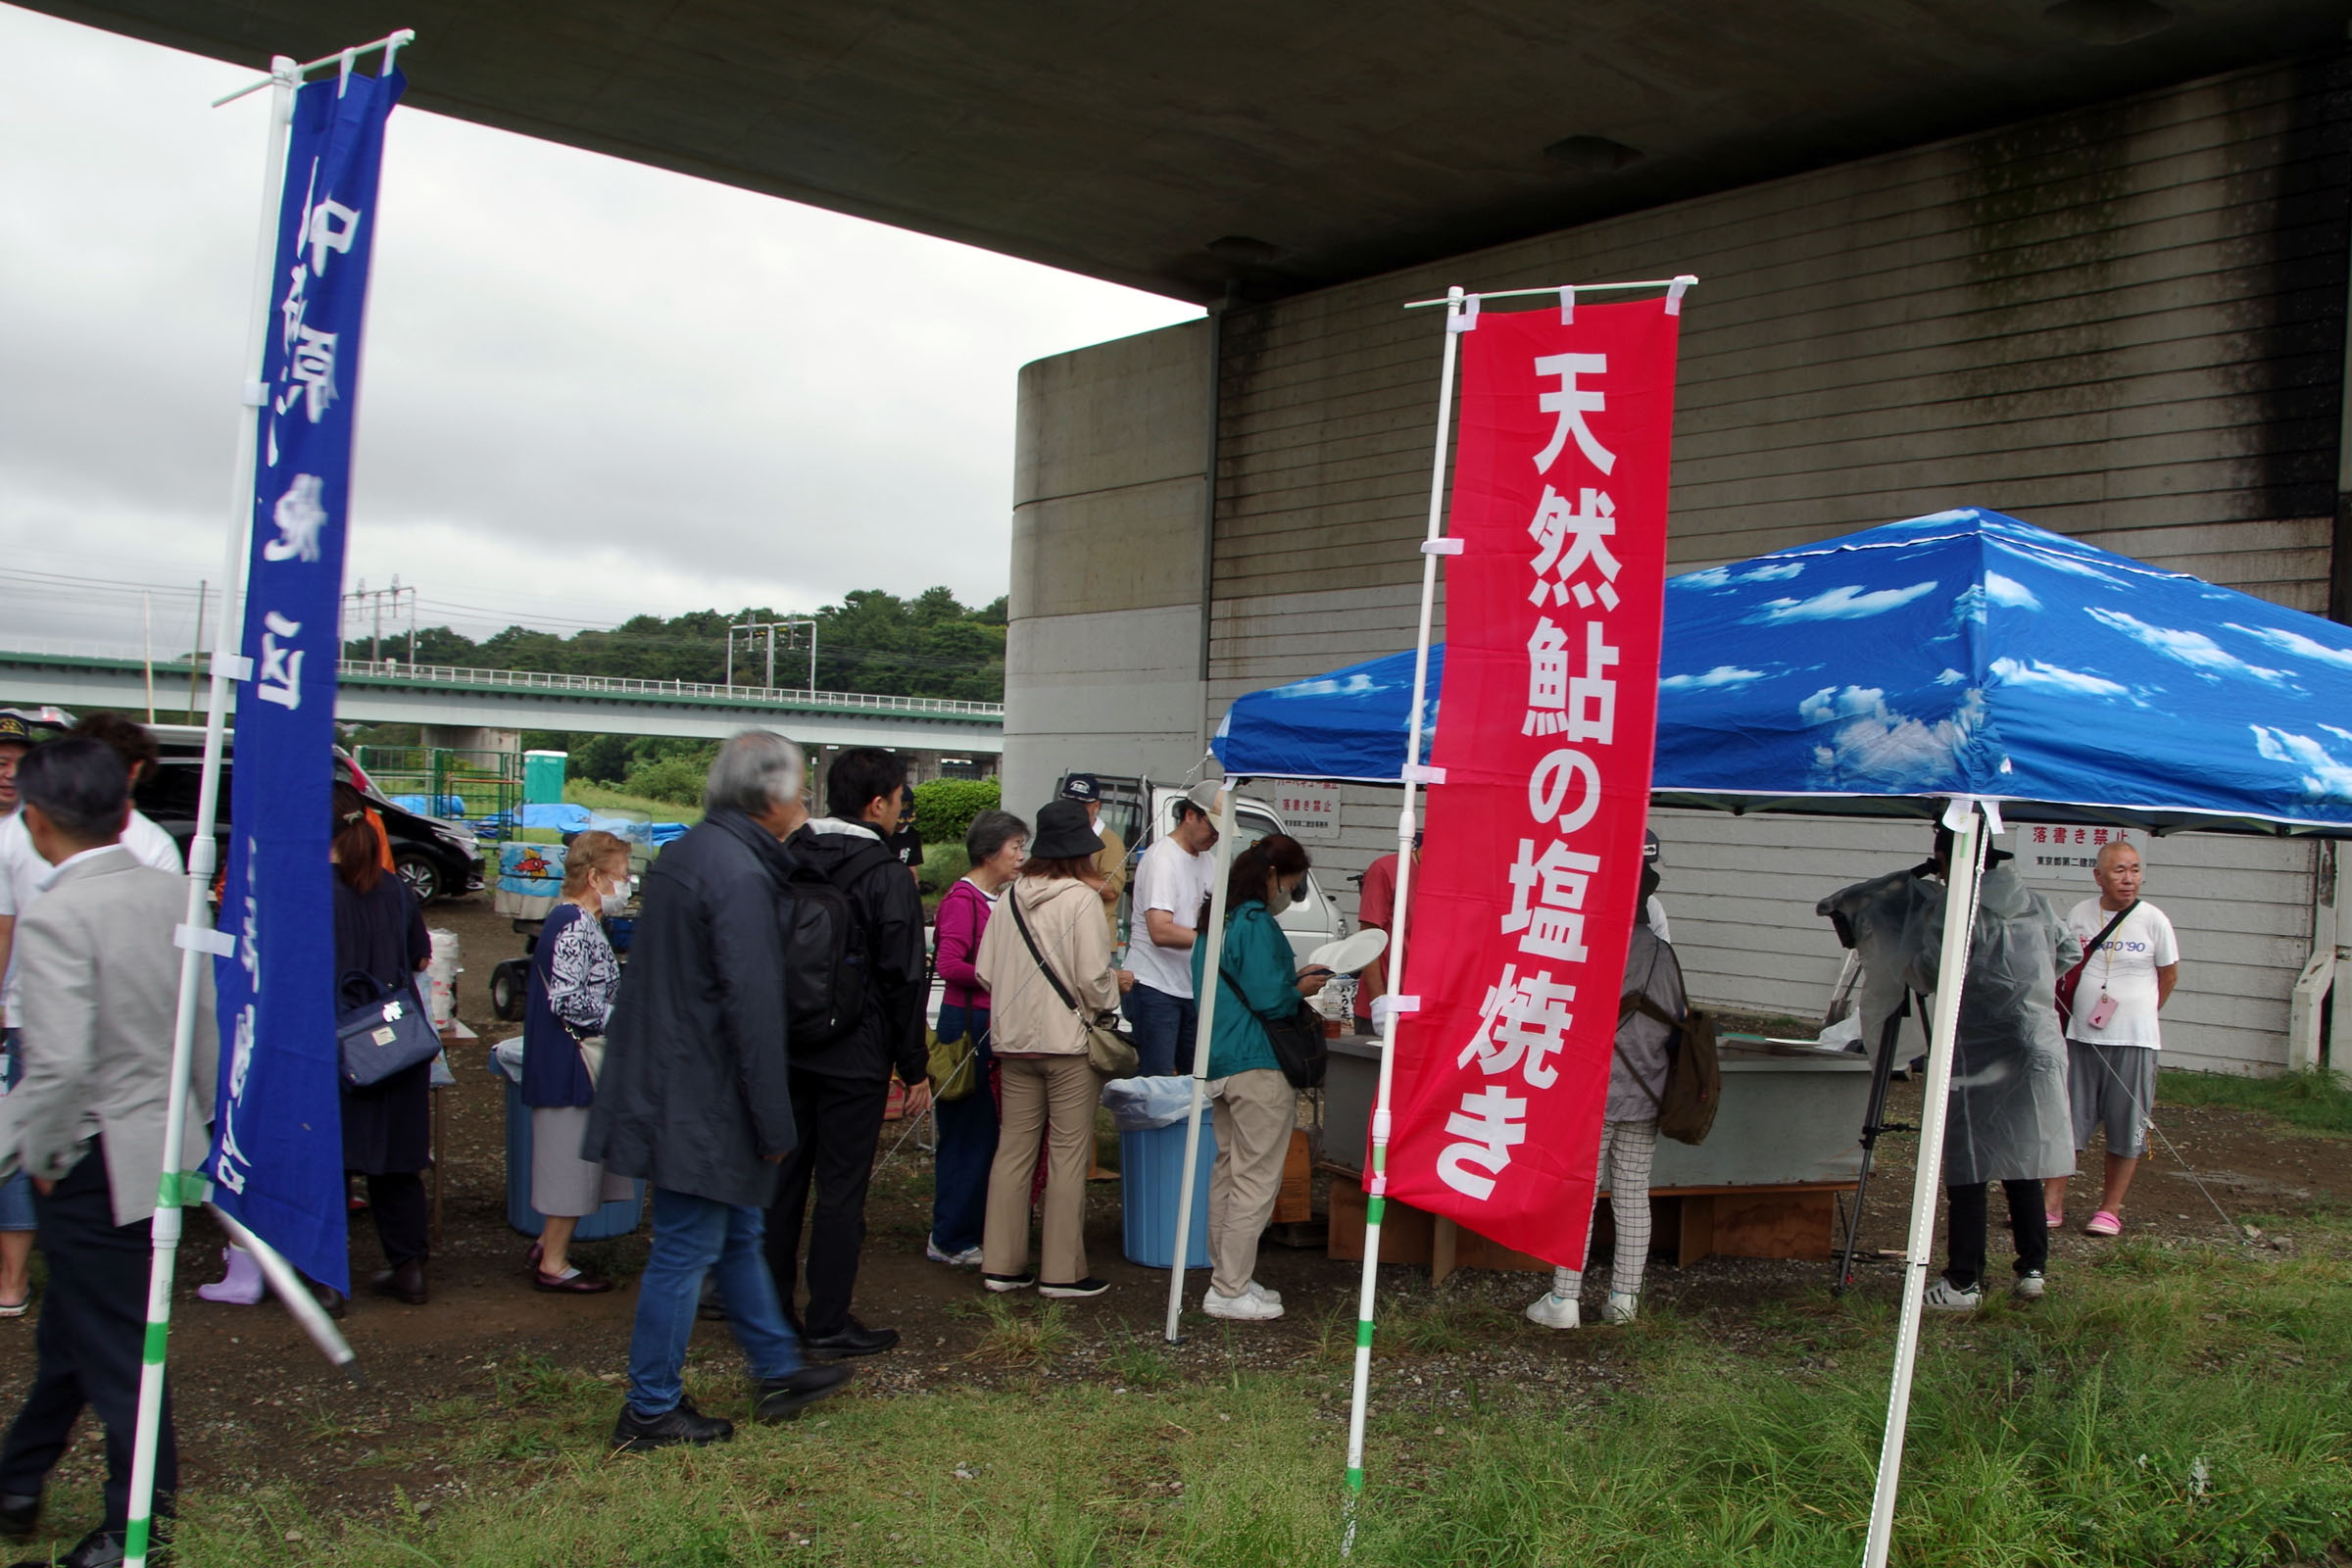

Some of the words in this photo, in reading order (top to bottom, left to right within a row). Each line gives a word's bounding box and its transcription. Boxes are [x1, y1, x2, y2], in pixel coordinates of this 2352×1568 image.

[1435, 352, 1622, 1201] 天然鮎の塩焼き
[2033, 826, 2129, 846] 落書き禁止
